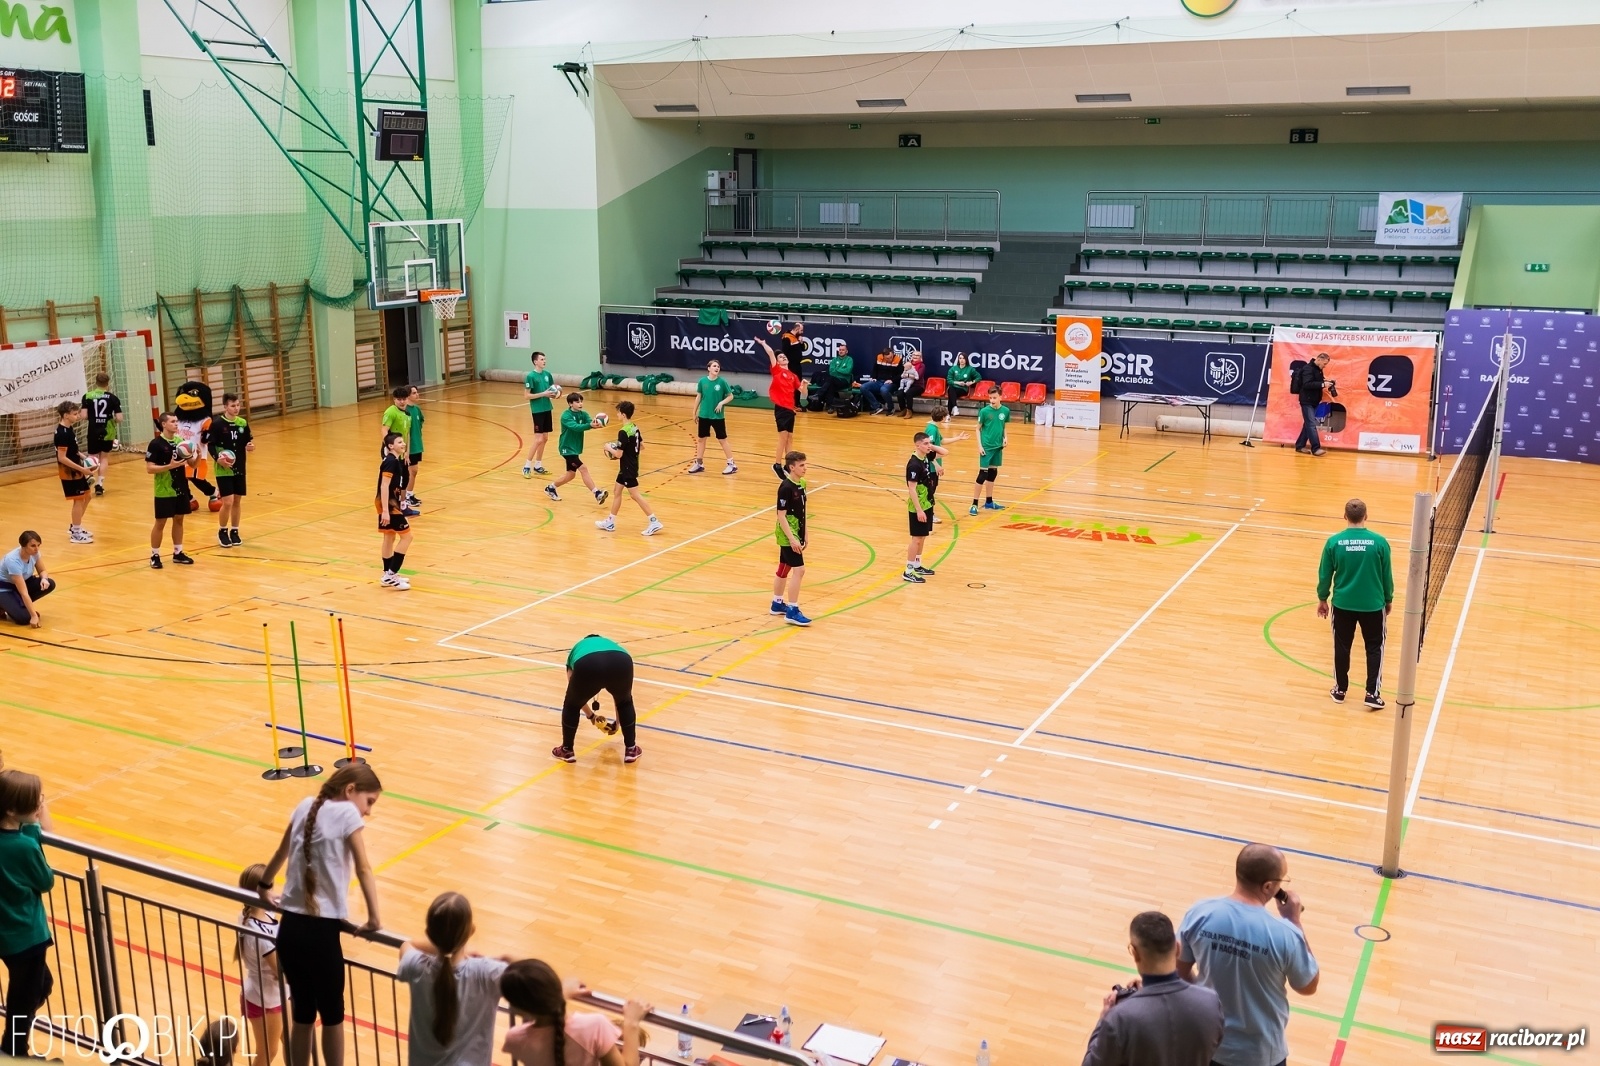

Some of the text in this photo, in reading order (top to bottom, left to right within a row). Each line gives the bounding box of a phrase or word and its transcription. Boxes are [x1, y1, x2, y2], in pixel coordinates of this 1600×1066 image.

[14, 110, 38, 122] GOŚCIE
[1305, 134, 1314, 142] B
[1414, 226, 1451, 234] raciborski
[1296, 332, 1315, 341] GRAJ
[1321, 333, 1374, 342] JASTRZĘBSKIM
[1377, 335, 1412, 344] WĘGLEM!
[670, 333, 756, 355] RACIBÓRZ
[1100, 351, 1154, 376] OSiR
[1114, 375, 1154, 385] RACIBÓRZ
[1480, 374, 1530, 384] RACÓRZ
[92, 399, 108, 418] 12
[1211, 942, 1218, 951] W
